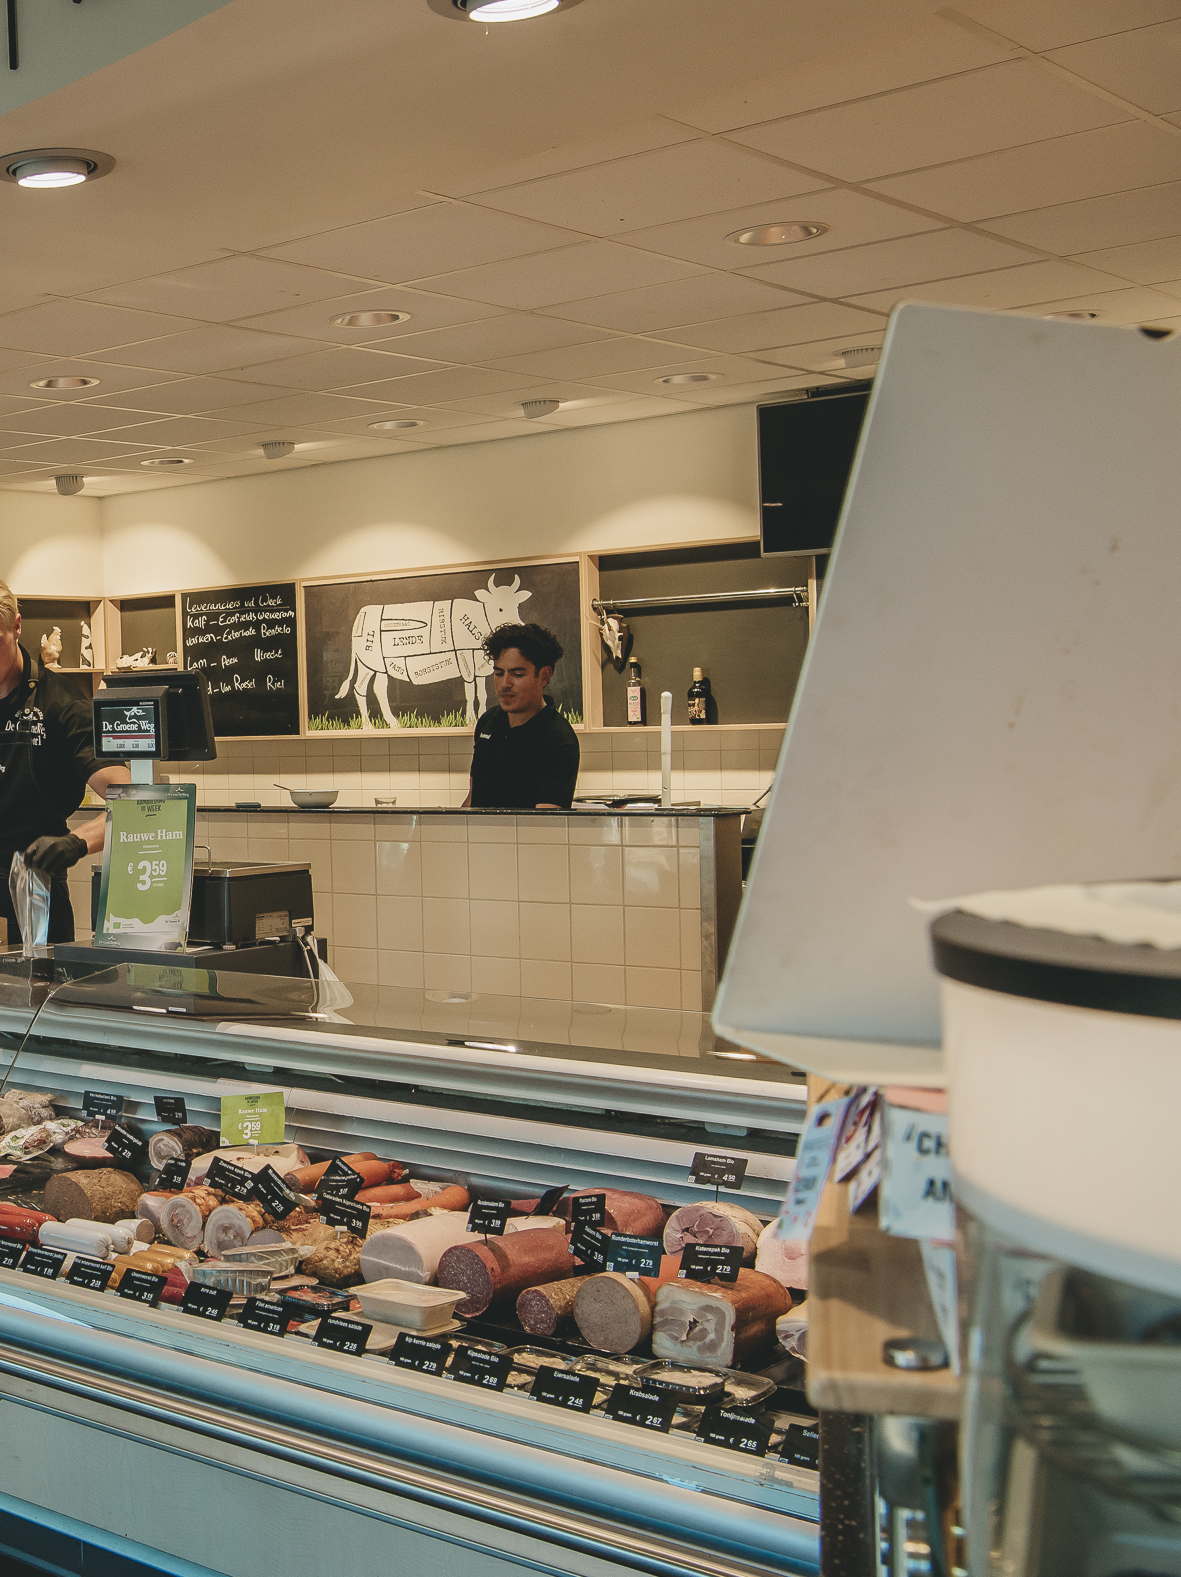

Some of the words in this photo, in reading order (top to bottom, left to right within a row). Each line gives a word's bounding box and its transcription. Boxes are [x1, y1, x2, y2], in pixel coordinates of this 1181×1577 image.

[187, 597, 240, 612] Leveranciers
[259, 594, 283, 606] Week
[187, 615, 207, 629] Kalf
[219, 612, 256, 625] Ecofields
[438, 608, 447, 645] RIBSTUK
[460, 614, 482, 641] HALS
[365, 631, 375, 651] BIL
[393, 635, 424, 647] LENDE
[187, 657, 207, 670] Lam
[255, 648, 282, 661] Utrecht
[414, 658, 453, 678] BORSTSTUK
[102, 721, 112, 731] De
[114, 721, 138, 731] Groene
[139, 720, 155, 733] Weg
[147, 805, 162, 813] WEEK
[119, 831, 155, 843] Rauwe
[157, 829, 183, 841] Ham
[705, 1155, 726, 1164] Lamsham
[322, 1192, 343, 1203] Gebraden
[362, 1204, 370, 1212] Bio
[611, 1234, 659, 1247] Runderboterhamworst
[695, 1245, 720, 1254] Katenspek
[255, 1300, 265, 1308] Filet
[348, 1323, 362, 1331] salade
[413, 1338, 425, 1346] kerrie
[426, 1340, 441, 1349] salade
[467, 1349, 490, 1361] Kipsalade
[490, 1354, 499, 1363] Bio
[553, 1370, 580, 1383] Eiersalade
[629, 1388, 660, 1402] Krabsalade
[720, 1409, 756, 1424] Tonijnsalade
